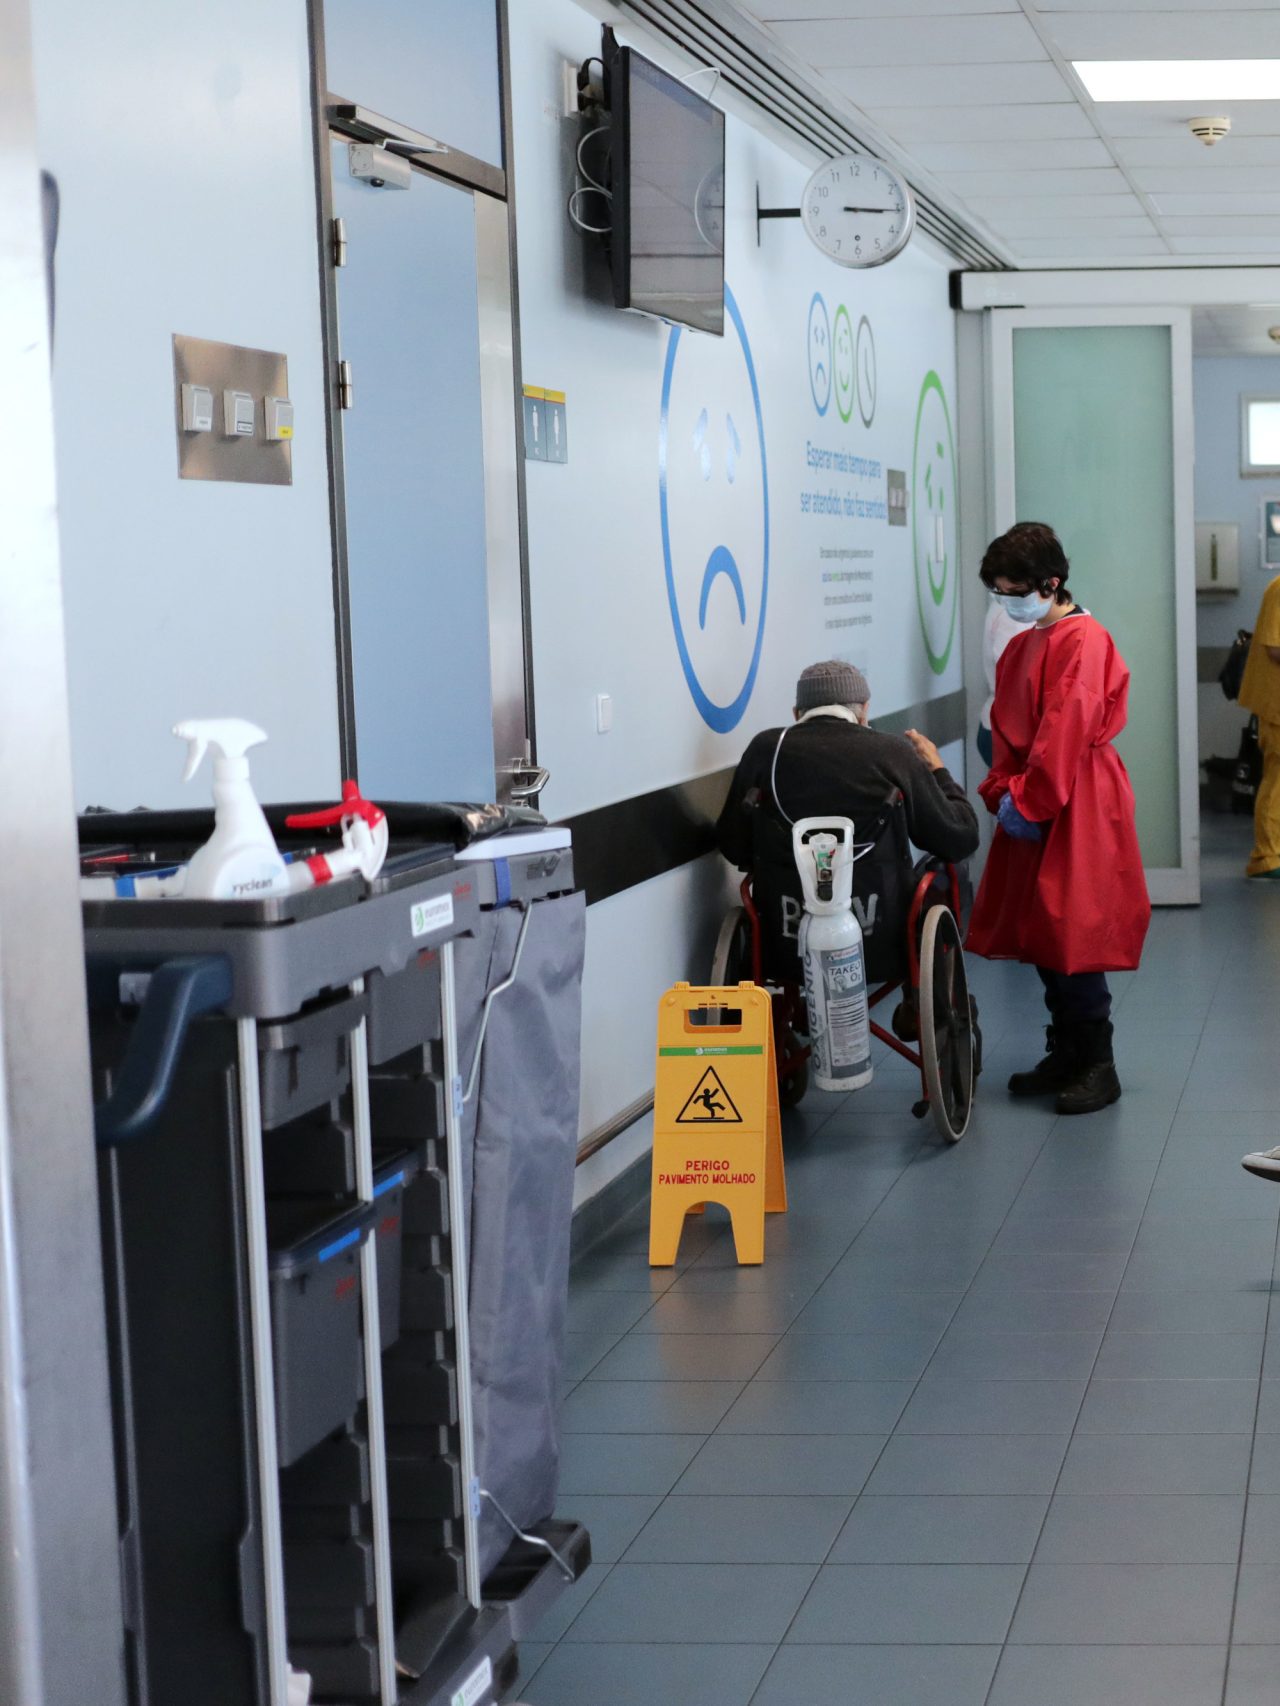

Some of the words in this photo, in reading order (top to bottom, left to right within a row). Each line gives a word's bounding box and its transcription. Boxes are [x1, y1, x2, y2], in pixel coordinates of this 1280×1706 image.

[850, 165, 860, 176] 12
[873, 170, 878, 180] 1
[831, 172, 840, 182] 11
[818, 187, 829, 198] 10
[888, 184, 894, 195] 2
[813, 206, 820, 216] 9
[820, 226, 827, 237] 8
[888, 225, 894, 234] 4
[836, 240, 841, 250] 7
[875, 239, 880, 249] 5
[855, 245, 861, 255] 6
[807, 440, 832, 475] Esperar
[685, 1160, 730, 1171] PERIGO
[658, 1174, 708, 1185] PAVIMENTO
[712, 1173, 756, 1184] MOLHADO
